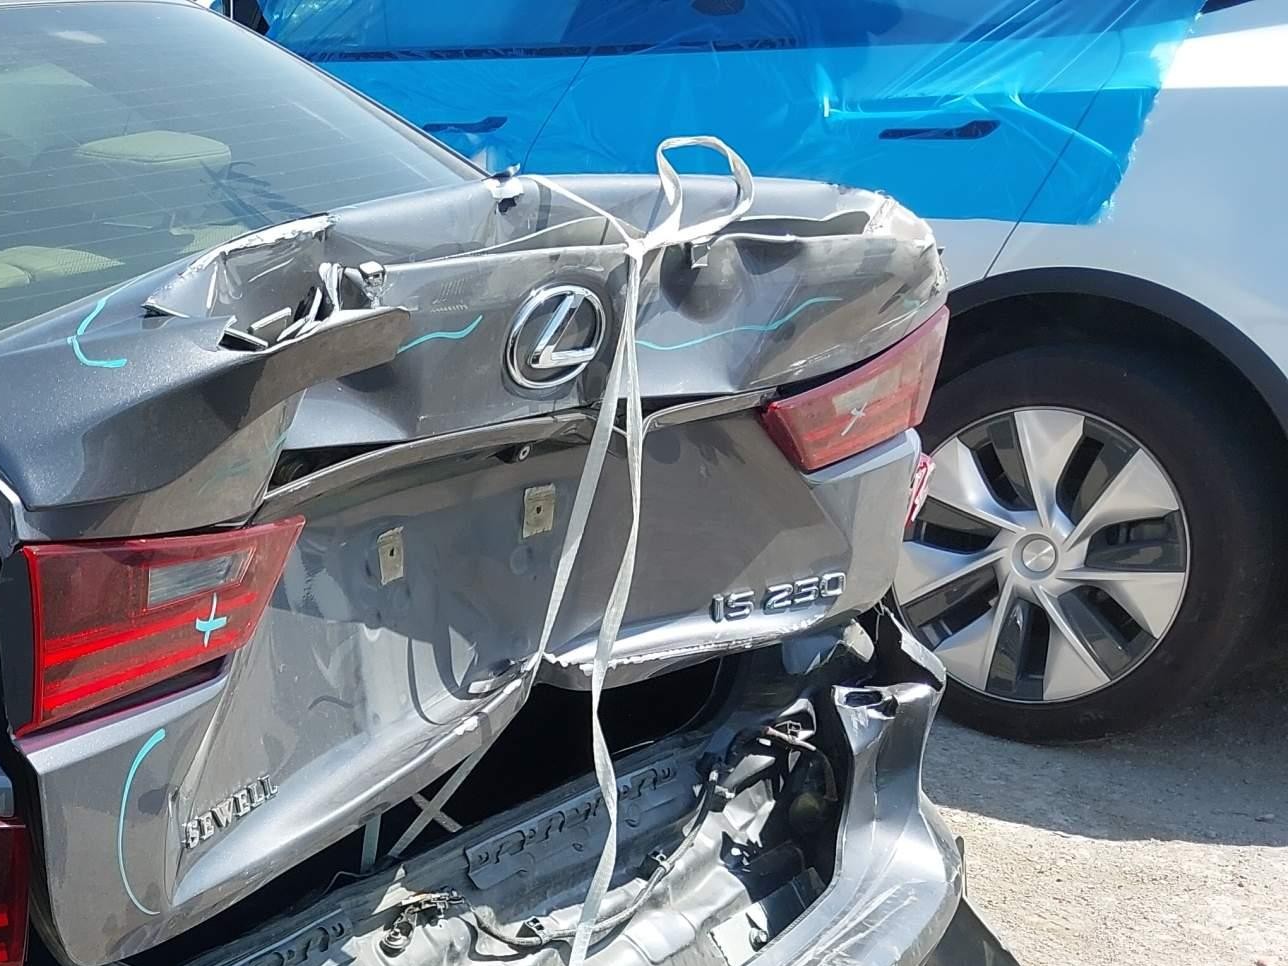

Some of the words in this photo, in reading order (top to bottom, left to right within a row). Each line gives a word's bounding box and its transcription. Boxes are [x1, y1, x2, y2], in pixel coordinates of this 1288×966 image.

[711, 590, 754, 623] IS
[764, 572, 846, 611] 250
[181, 774, 279, 849] SEWELL
